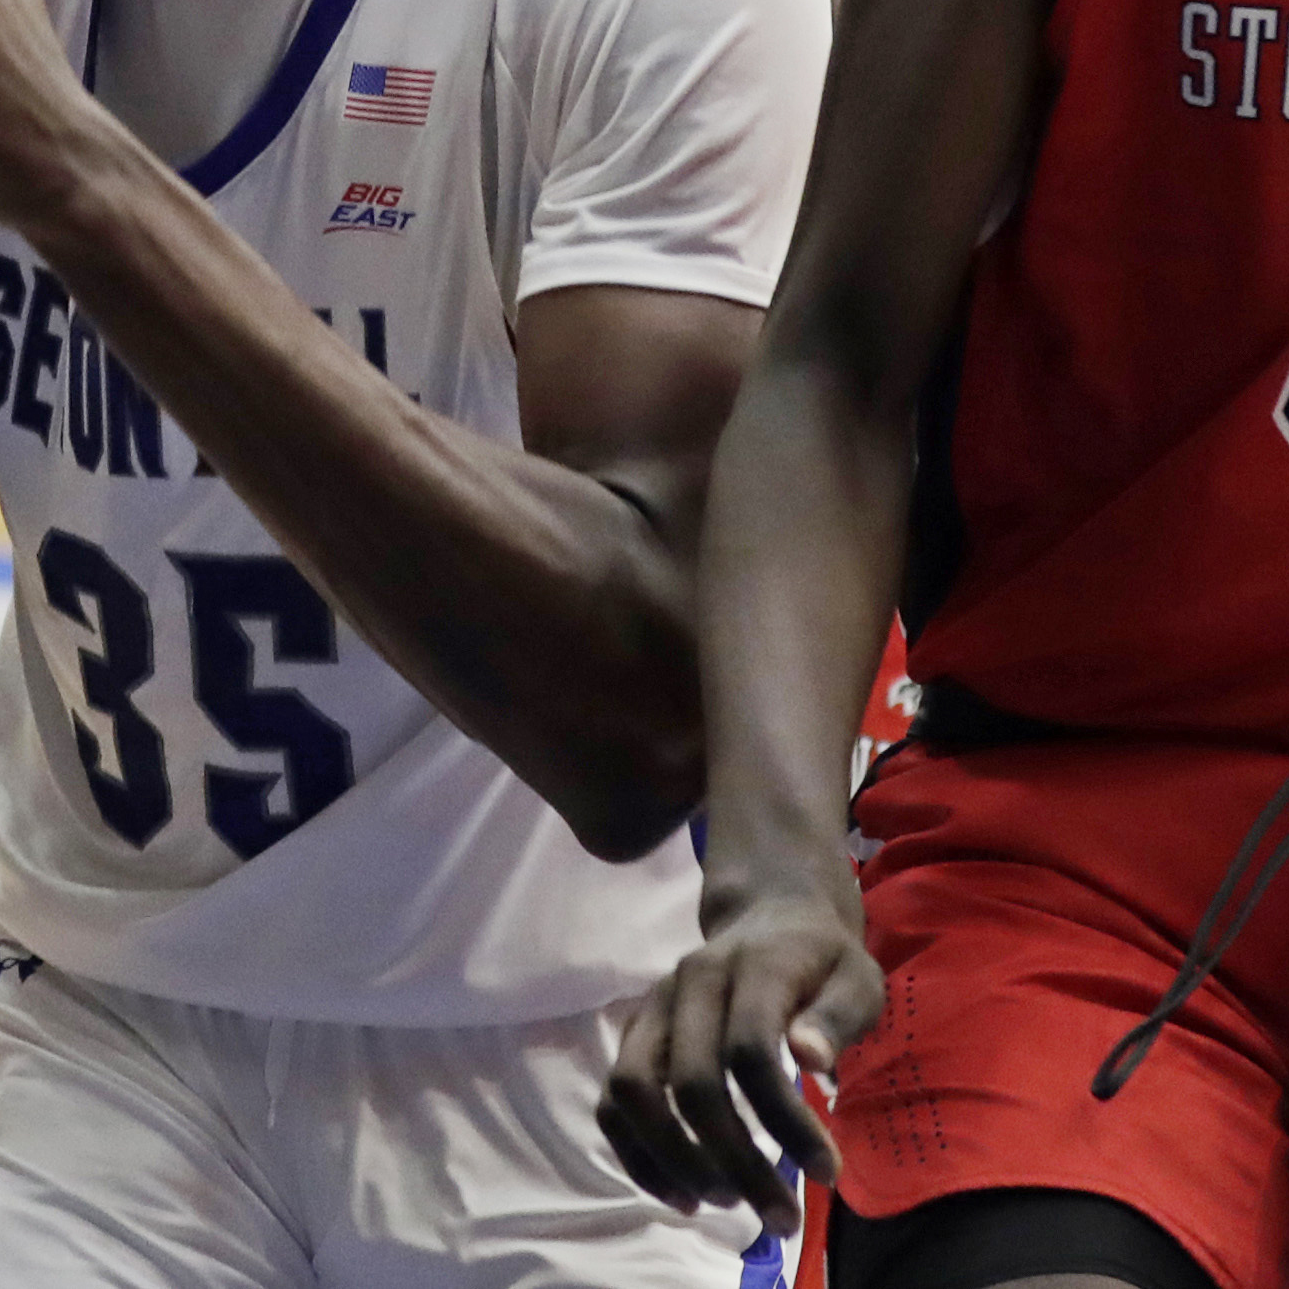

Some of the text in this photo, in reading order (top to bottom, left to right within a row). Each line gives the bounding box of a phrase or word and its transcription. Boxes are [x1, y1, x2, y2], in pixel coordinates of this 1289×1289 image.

[341, 181, 404, 208] BIG
[329, 203, 417, 231] EAST
[36, 526, 357, 862] 35
